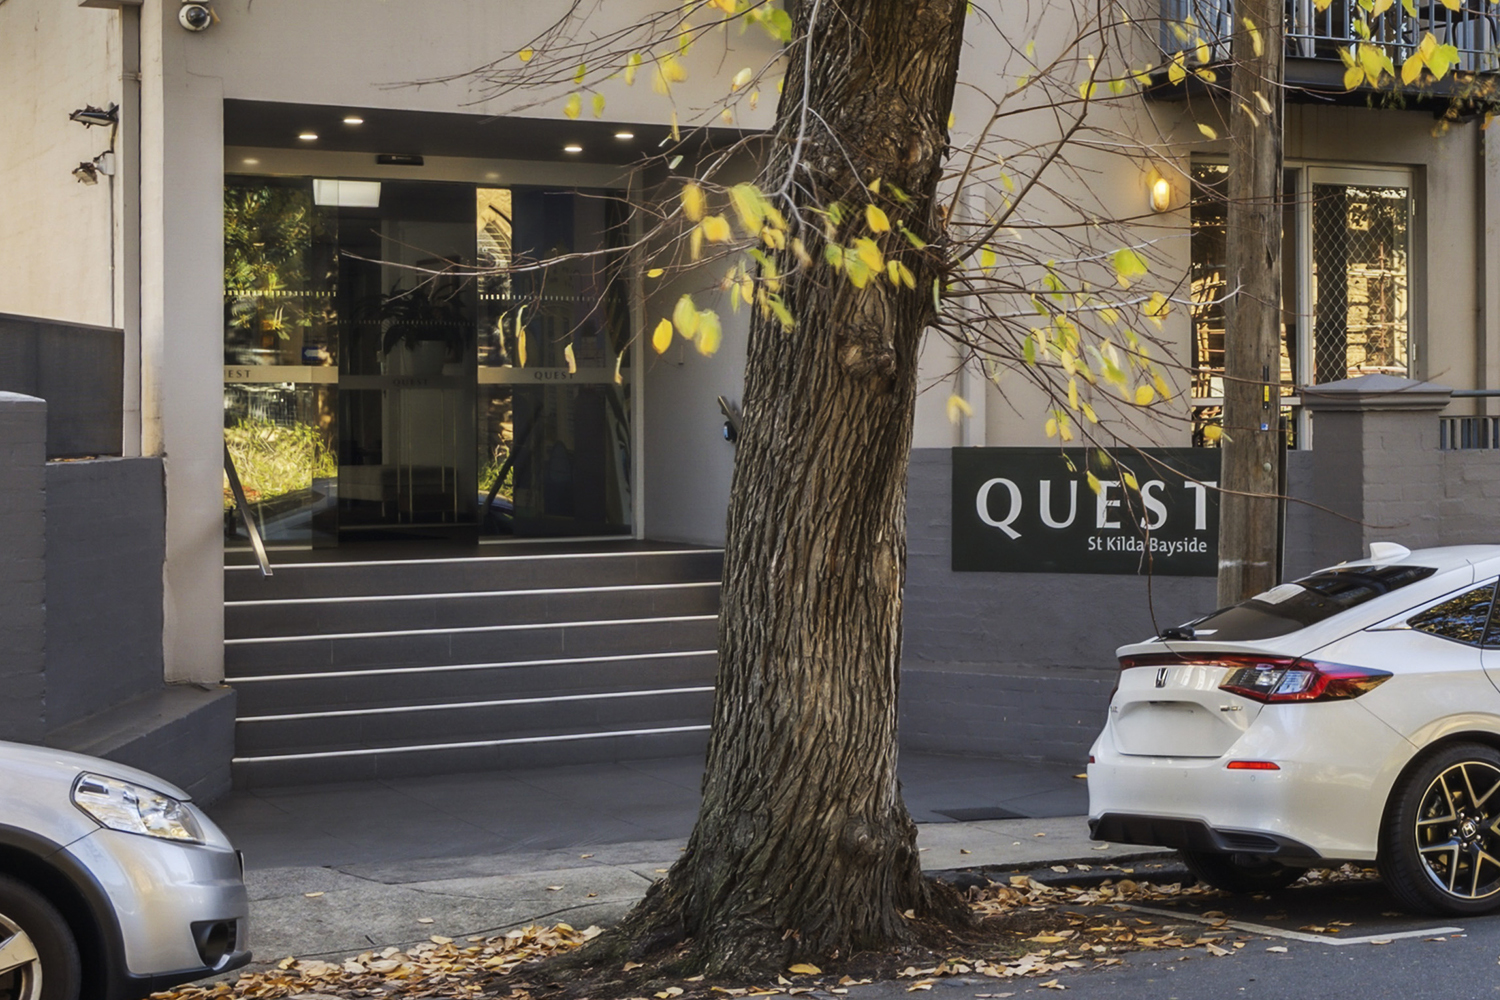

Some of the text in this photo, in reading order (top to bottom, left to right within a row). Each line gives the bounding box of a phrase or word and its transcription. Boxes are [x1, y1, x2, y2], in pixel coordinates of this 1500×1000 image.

[224, 369, 250, 378] EST
[976, 477, 1217, 540] QUEST
[1088, 536, 1207, 557] St Kilda Bayside
